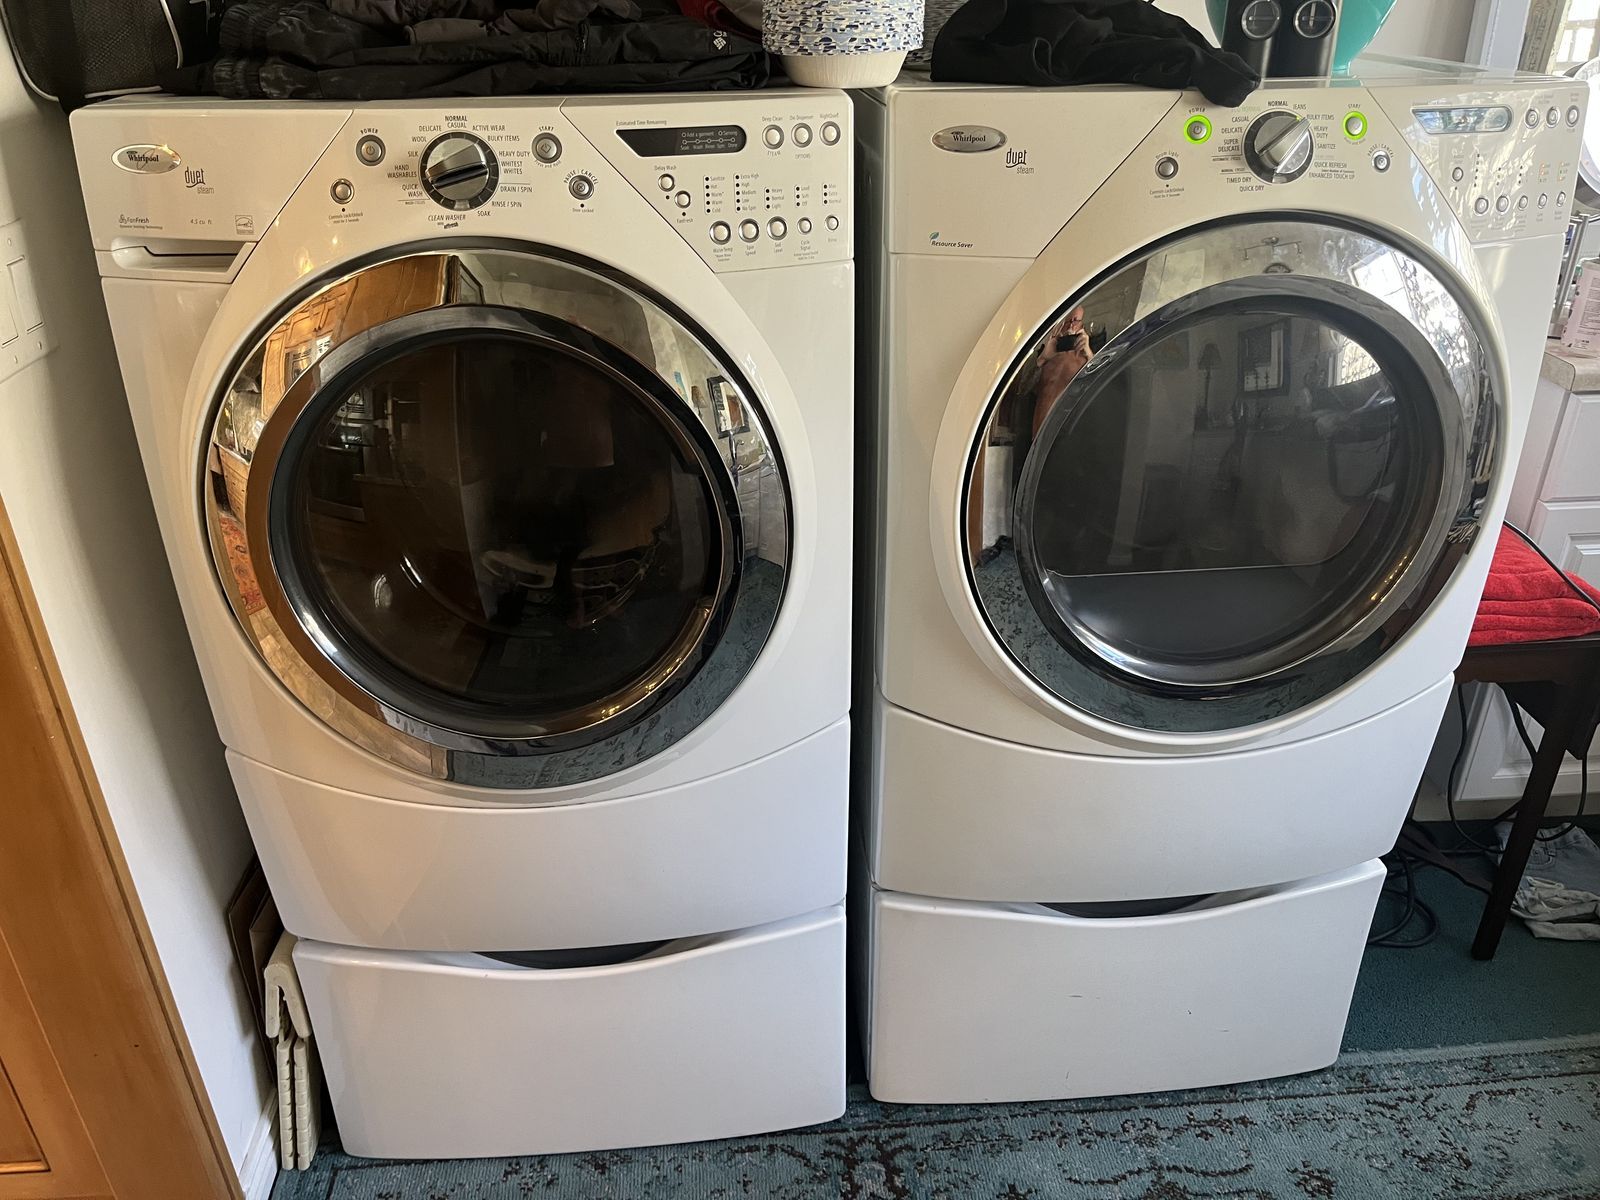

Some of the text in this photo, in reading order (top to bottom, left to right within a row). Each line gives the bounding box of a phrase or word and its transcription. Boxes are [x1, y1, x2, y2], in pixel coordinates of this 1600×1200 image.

[953, 135, 986, 143] Whirlpool
[128, 154, 159, 163] Whirlpool
[1006, 148, 1027, 168] duet
[184, 166, 206, 188] duet
[564, 170, 577, 184] PAUSE
[580, 169, 598, 184] CANCEL
